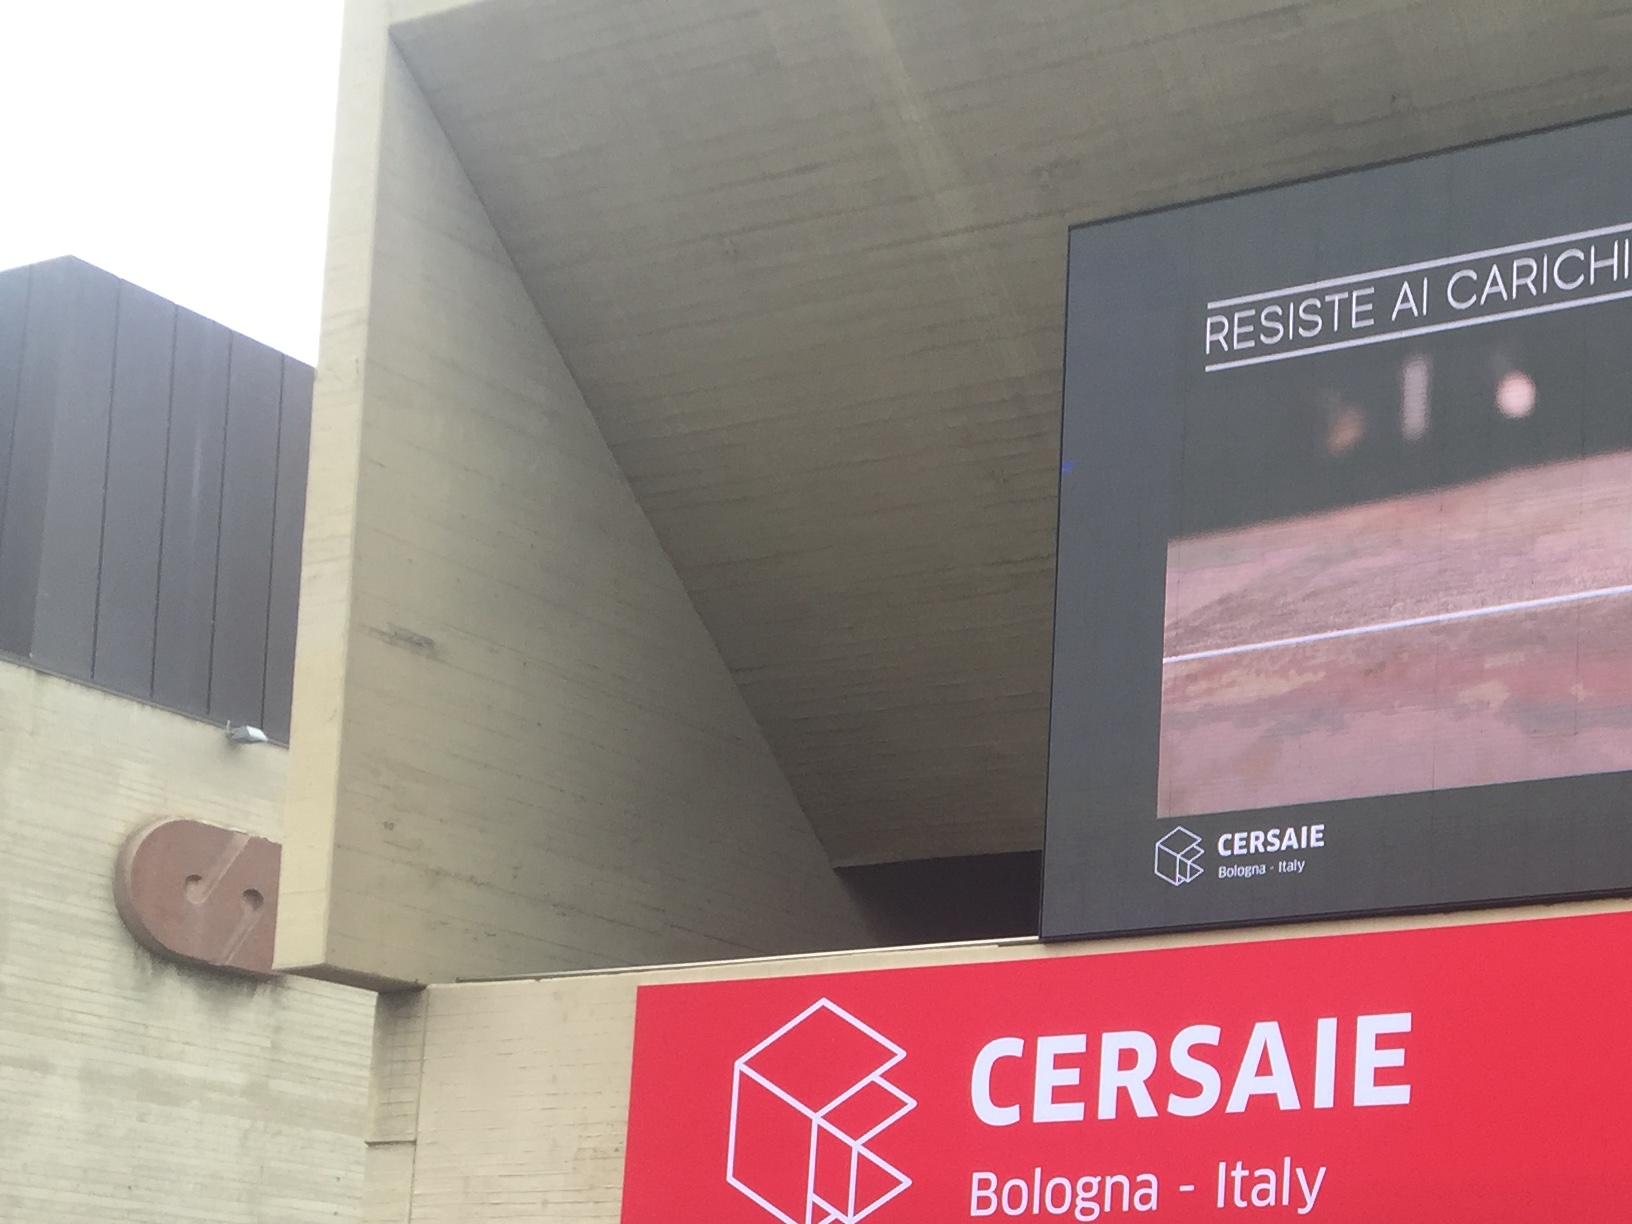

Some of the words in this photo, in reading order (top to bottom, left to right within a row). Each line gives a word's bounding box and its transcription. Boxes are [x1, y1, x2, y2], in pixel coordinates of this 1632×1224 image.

[1205, 287, 1375, 355] RESISTE
[1391, 276, 1428, 322] AI
[1446, 239, 1630, 310] CARICHI
[1217, 823, 1325, 857] CERSAIE
[1218, 864, 1266, 879] Bologna
[1278, 859, 1305, 874] Italy
[970, 1012, 1412, 1127] CERSAIE
[970, 1167, 1158, 1222] Bologna
[1217, 1156, 1327, 1215] Italy
